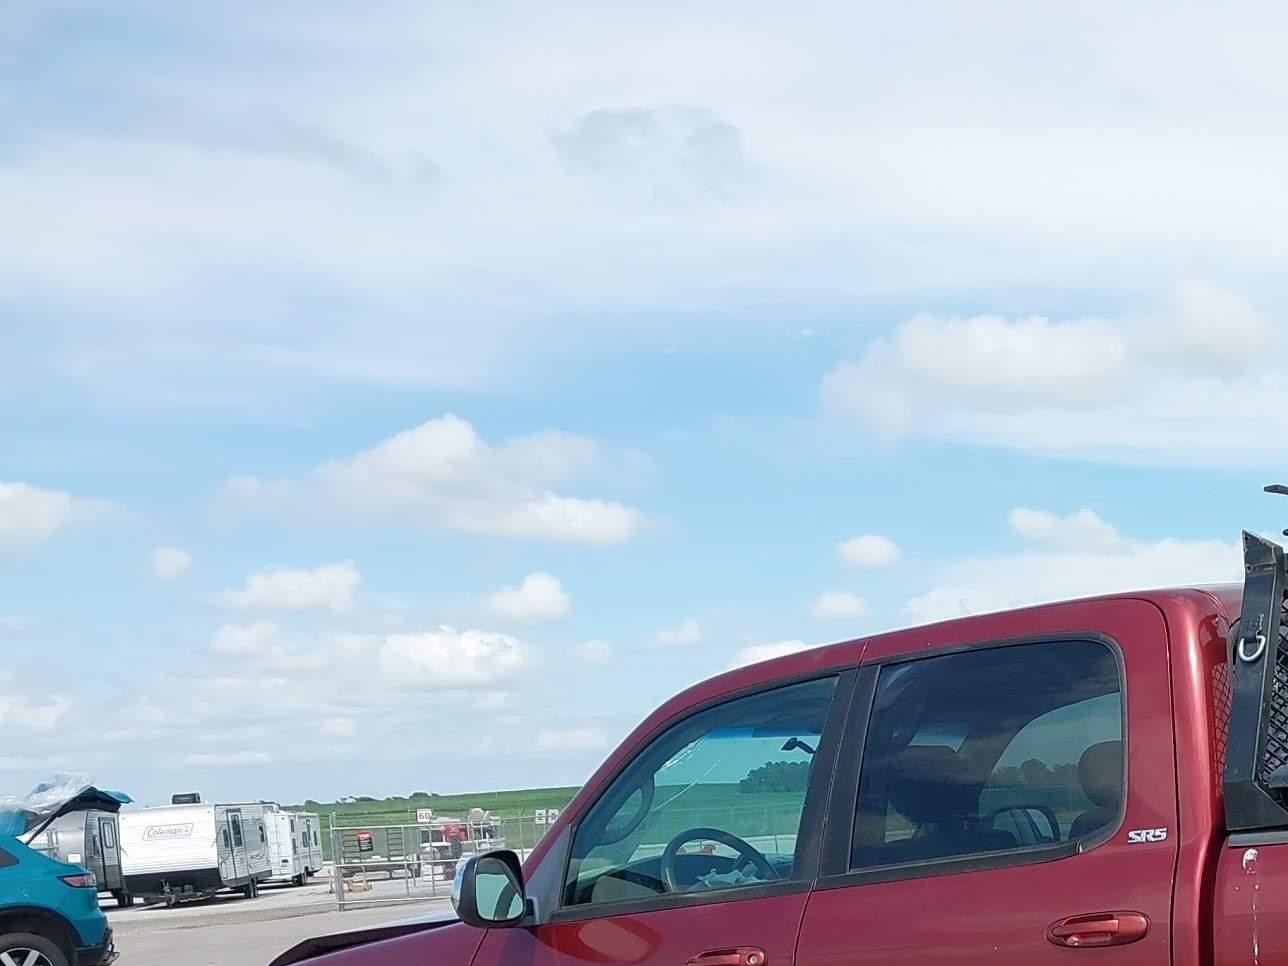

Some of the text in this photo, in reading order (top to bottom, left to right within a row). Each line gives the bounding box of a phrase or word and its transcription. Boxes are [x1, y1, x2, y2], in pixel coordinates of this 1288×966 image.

[418, 811, 431, 820] 60
[147, 827, 183, 838] Coleman
[1127, 827, 1168, 844] SR5
